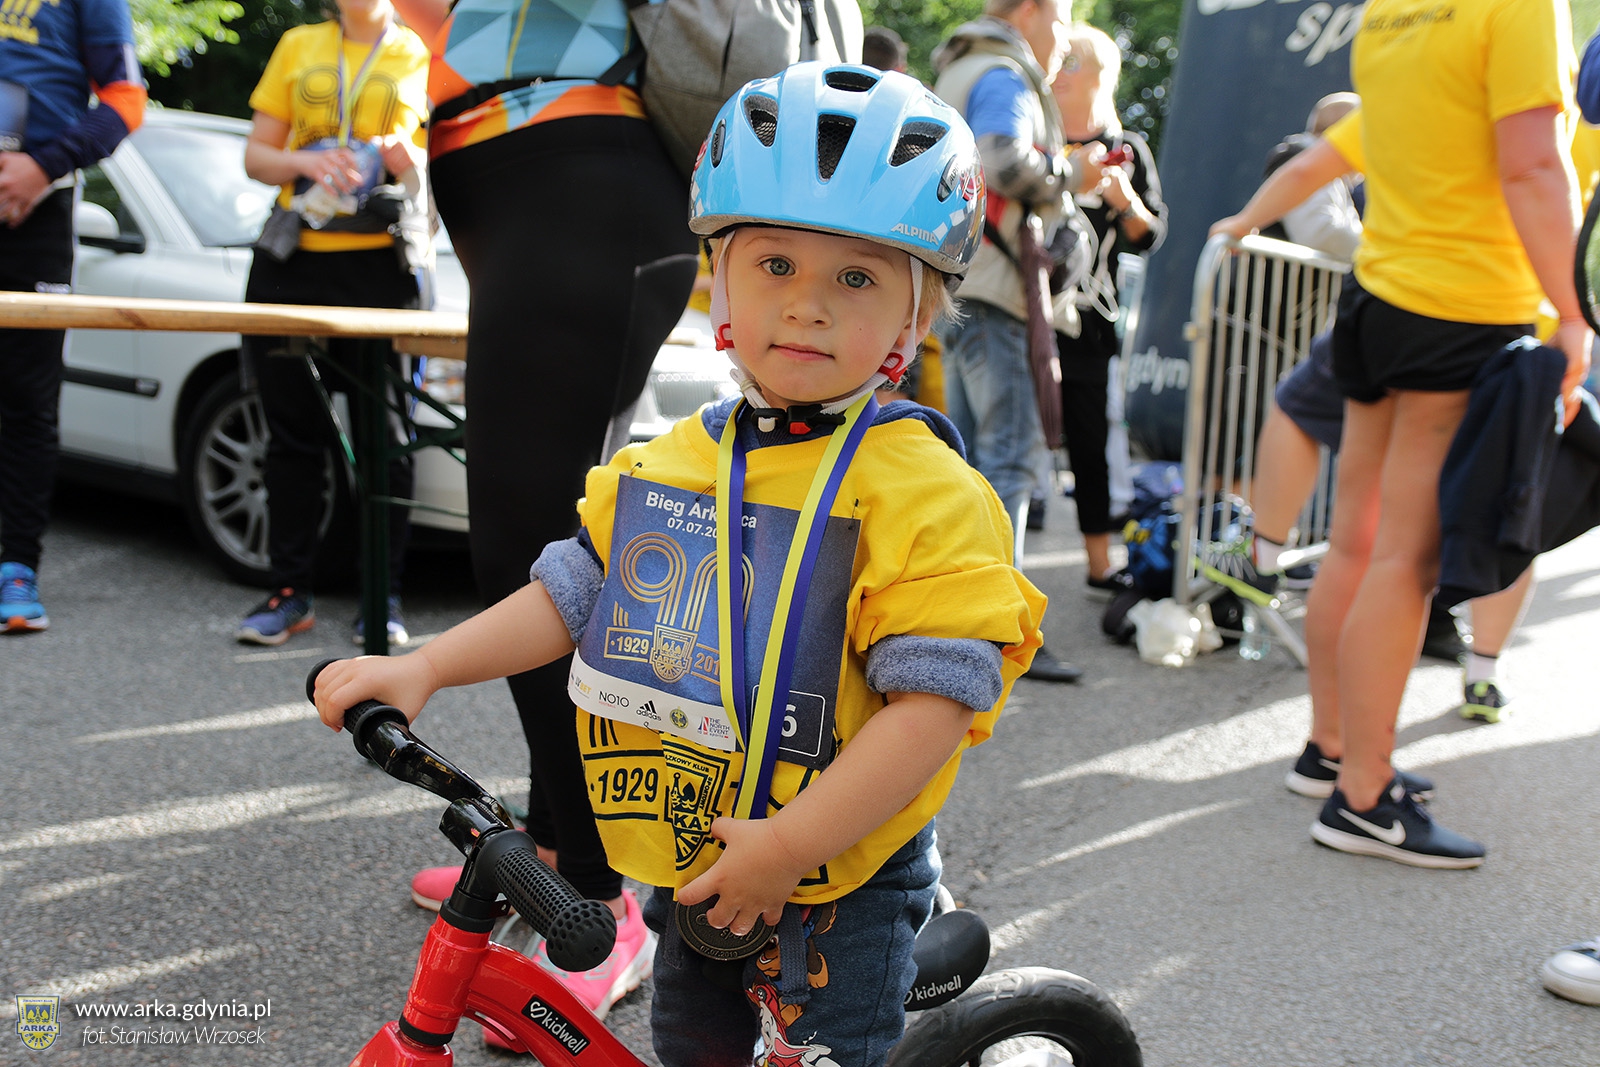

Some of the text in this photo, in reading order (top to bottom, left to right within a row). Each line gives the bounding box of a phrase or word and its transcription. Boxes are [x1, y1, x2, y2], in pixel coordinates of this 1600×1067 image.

[1285, 2, 1366, 67] sp
[890, 222, 939, 246] ALPINA
[1126, 345, 1191, 395] gdyn
[645, 491, 758, 529] Bieg Arkca
[667, 517, 718, 539] 07.07.20
[616, 636, 720, 676] 1929 201
[599, 691, 630, 708] NO10
[636, 709, 662, 722] adidas
[709, 722, 730, 731] NORTH
[665, 754, 710, 773] ZKOWY KLUB
[597, 767, 659, 803] 1929
[674, 813, 703, 831] KA
[915, 975, 962, 1001] kidwell
[541, 1010, 587, 1055] kidwell
